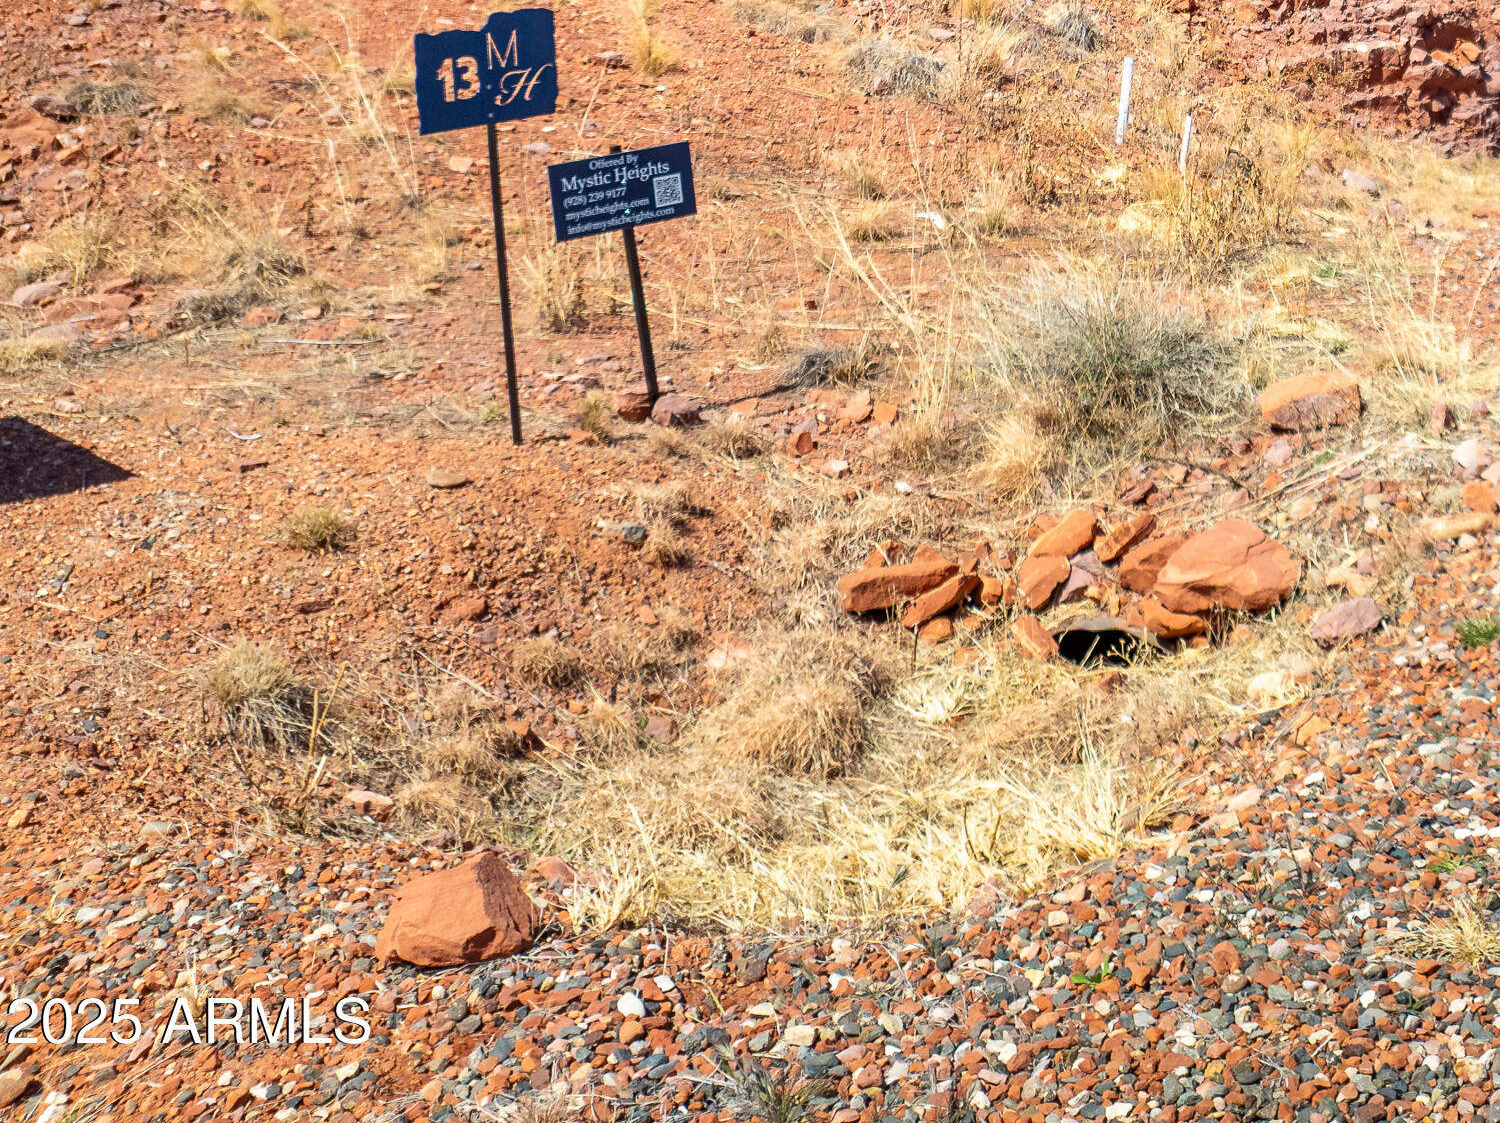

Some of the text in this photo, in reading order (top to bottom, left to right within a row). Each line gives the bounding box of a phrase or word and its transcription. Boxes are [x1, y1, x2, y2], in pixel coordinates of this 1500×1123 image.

[486, 29, 518, 70] M
[436, 55, 481, 103] 13
[494, 62, 554, 107] H
[561, 161, 670, 193] Mystic Heights
[589, 154, 638, 171] Offered By
[565, 197, 650, 221] mysticheights.com
[567, 207, 675, 235] info@mysticheights.com
